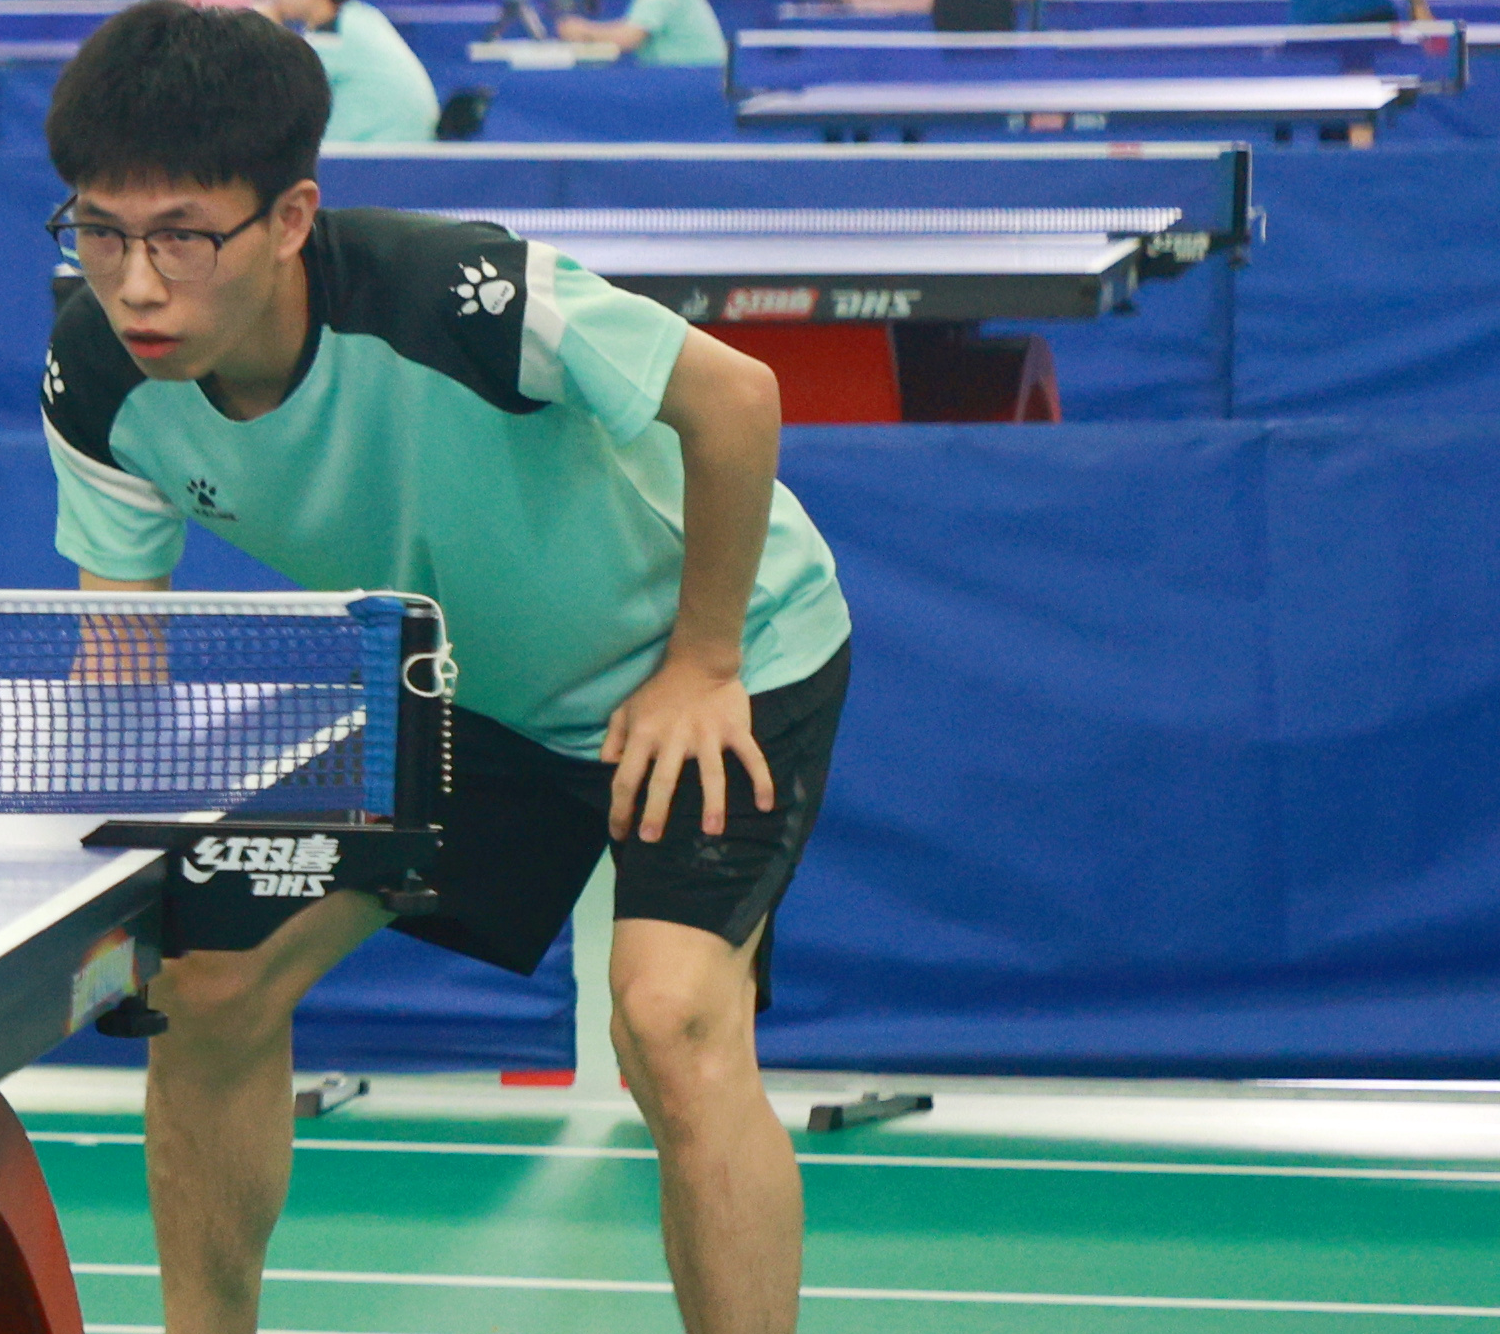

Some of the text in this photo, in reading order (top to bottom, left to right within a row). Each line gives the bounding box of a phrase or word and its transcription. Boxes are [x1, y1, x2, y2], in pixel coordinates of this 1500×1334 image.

[182, 833, 342, 884] 红双喜
[249, 873, 335, 897] DHS
